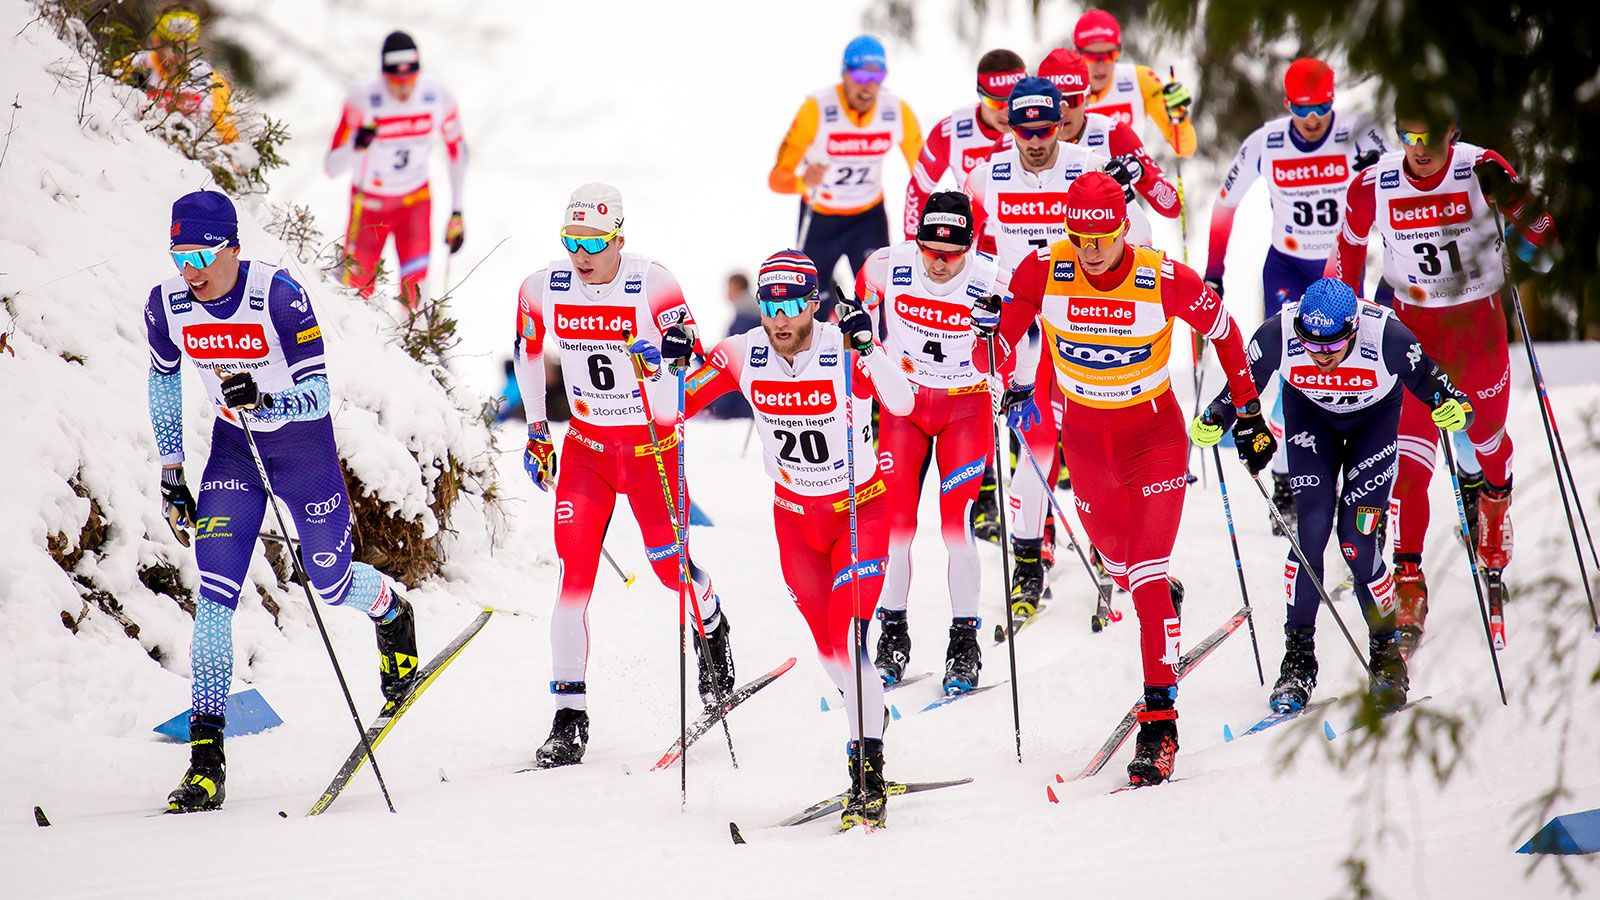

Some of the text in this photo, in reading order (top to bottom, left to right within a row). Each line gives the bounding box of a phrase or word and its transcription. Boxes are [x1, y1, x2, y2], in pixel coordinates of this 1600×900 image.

[989, 73, 1026, 86] LUKO
[1275, 163, 1346, 181] bett1.de
[1454, 168, 1471, 178] coop
[1067, 208, 1116, 220] LUKOIL
[1293, 198, 1339, 227] 33
[1392, 202, 1467, 222] bett1.de
[1413, 240, 1463, 276] 31
[1054, 271, 1075, 279] coop
[550, 281, 570, 289] coop
[625, 283, 642, 291] coop
[1135, 278, 1155, 287] coop
[171, 302, 192, 311] coop
[1070, 304, 1133, 319] bett1.de
[897, 301, 971, 326] bett1.de
[557, 313, 633, 331] bett1.de
[1070, 324, 1132, 336] Überlegen liegen
[187, 333, 263, 351] bett1.de
[559, 340, 624, 353] Überlegen lieg
[922, 340, 948, 364] 4
[1361, 349, 1378, 359] coop
[240, 359, 270, 370] liegen
[819, 356, 838, 365] coop
[587, 354, 616, 391] 6
[1293, 373, 1373, 387] bett1.de
[582, 390, 630, 400] OBERSTDORF
[754, 389, 832, 407] bett1.de
[1085, 389, 1129, 398] OBERSTDORF
[283, 389, 318, 415] FIN
[806, 416, 835, 427] liegen
[773, 429, 830, 464] 20
[200, 479, 249, 492] candic
[1344, 461, 1397, 506] FALCONE
[646, 544, 679, 561] SpareB
